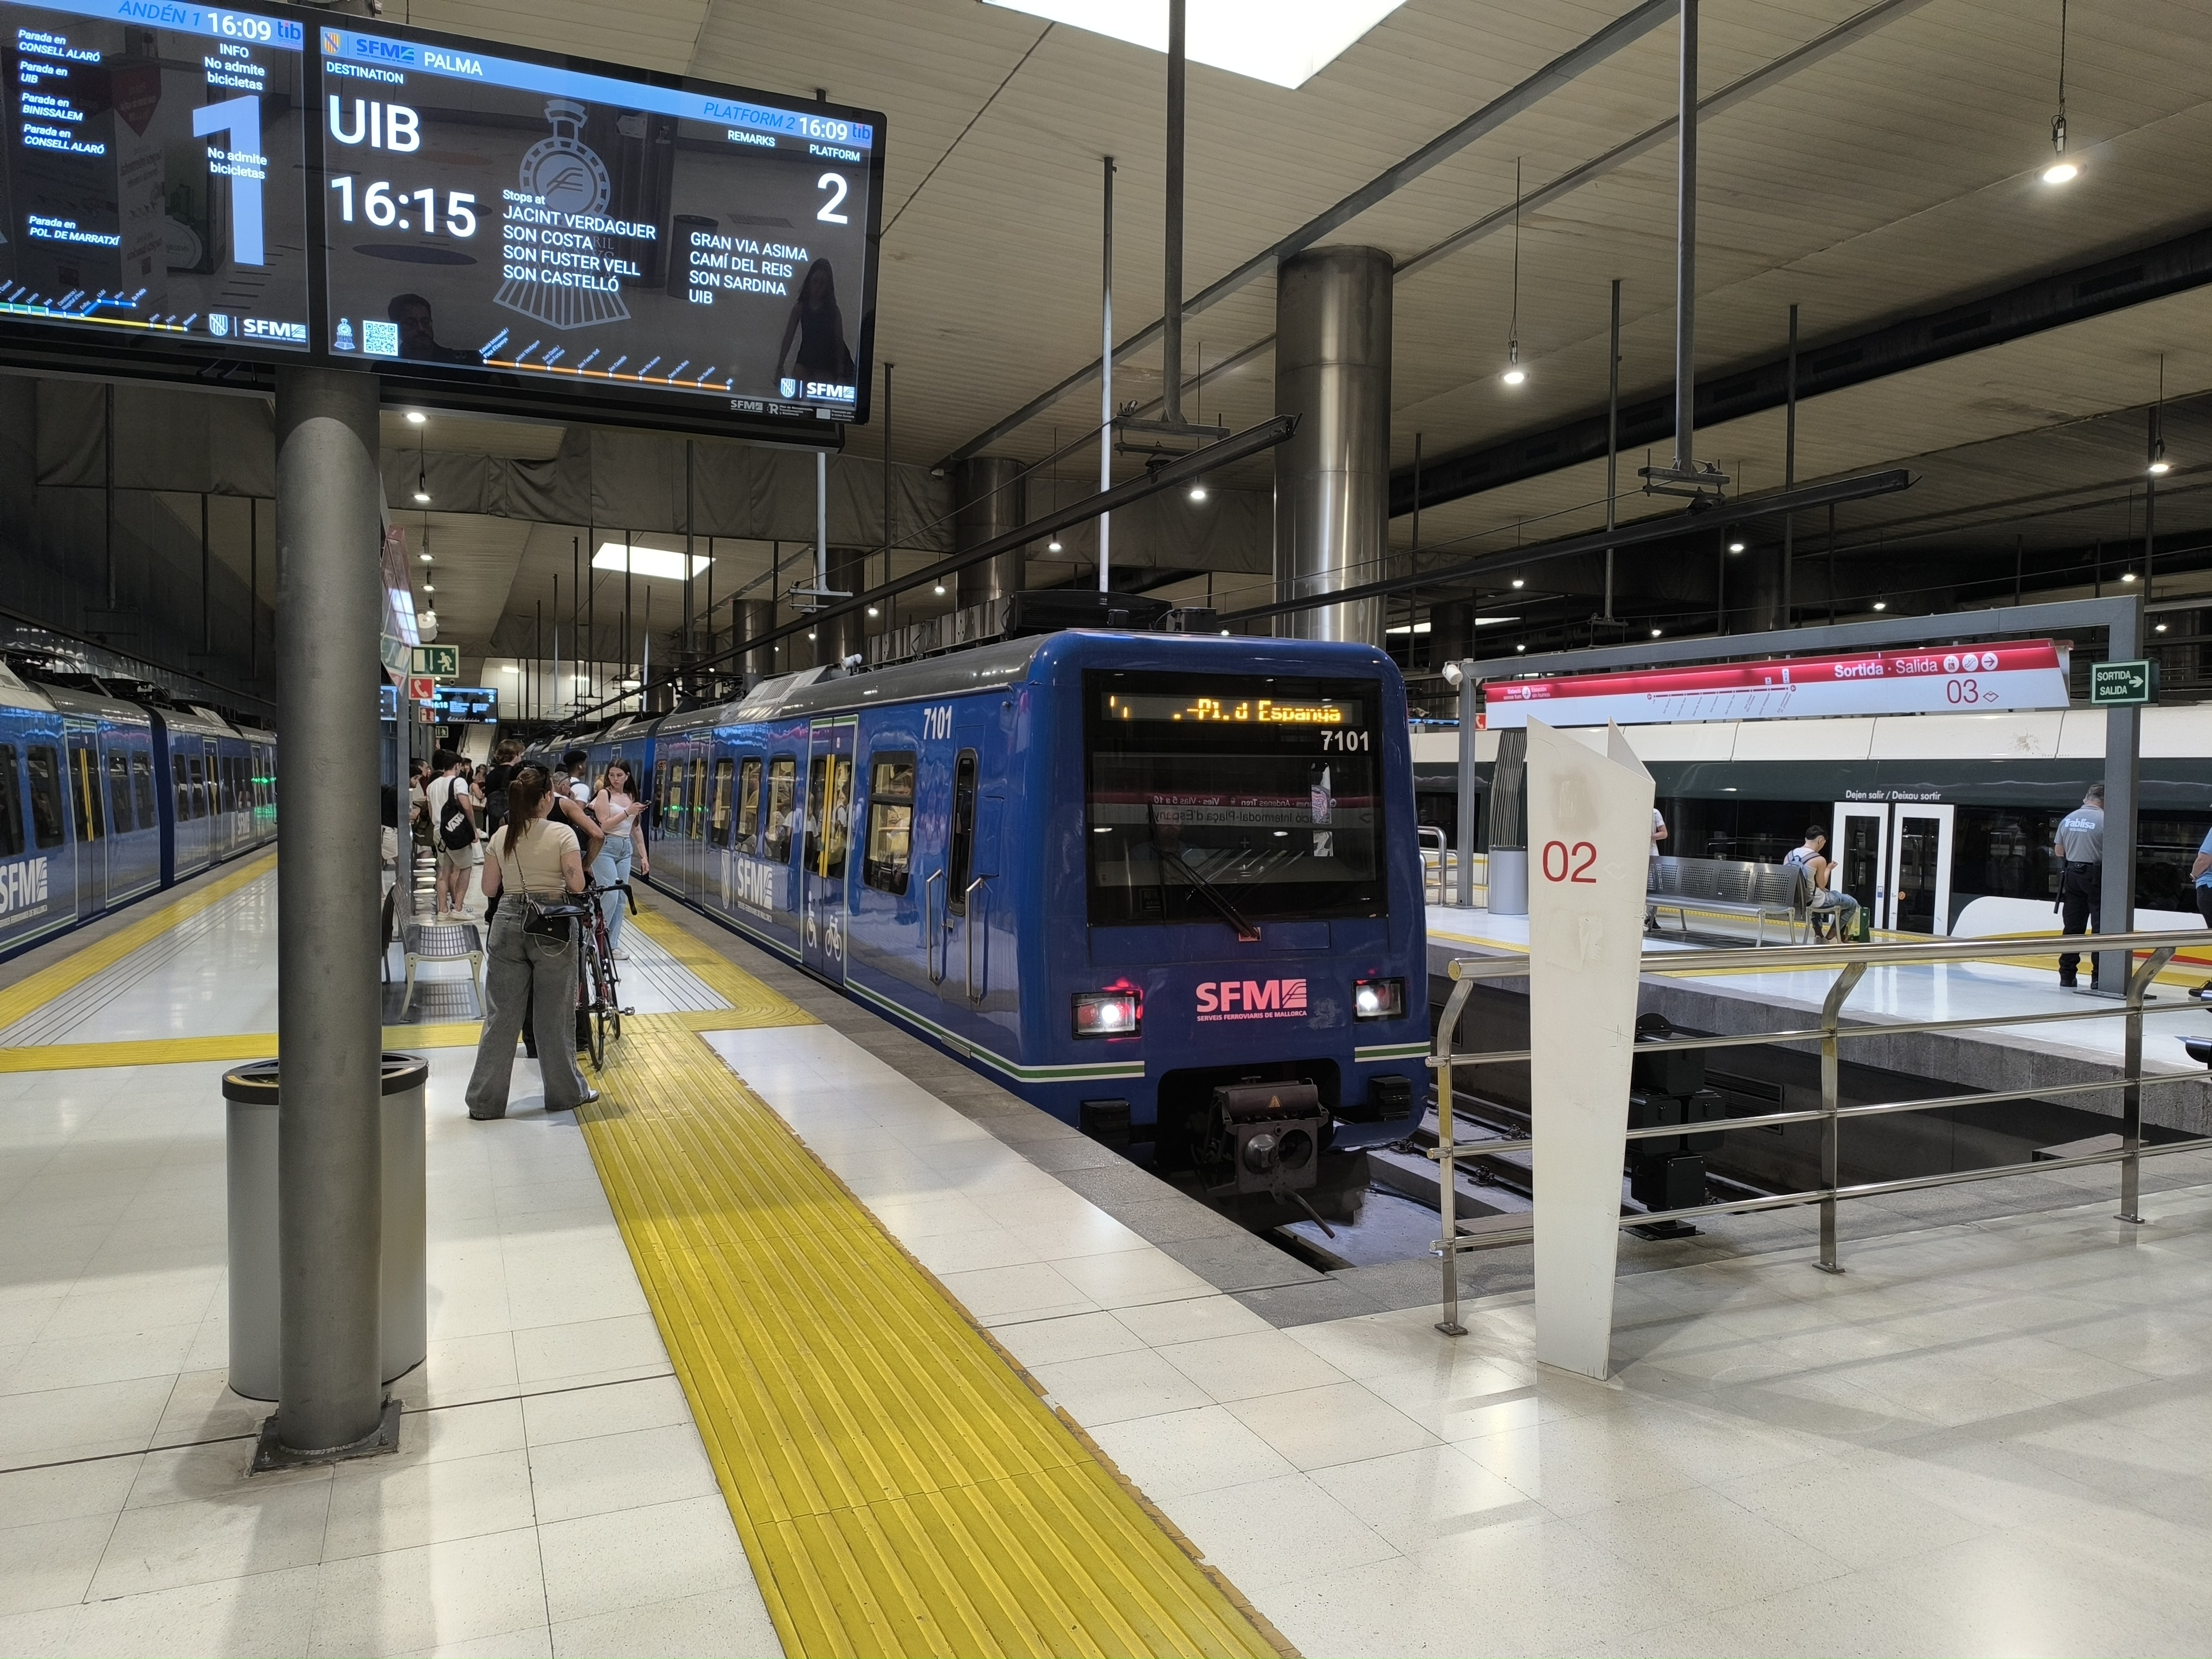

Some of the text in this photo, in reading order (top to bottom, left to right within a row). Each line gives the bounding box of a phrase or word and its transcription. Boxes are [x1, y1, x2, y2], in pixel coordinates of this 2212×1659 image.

[118, 0, 201, 26] ANDÉN 1
[208, 12, 271, 41] 16:09
[278, 22, 301, 40] tib
[18, 29, 66, 45] Parada en
[20, 42, 100, 62] CONSELL ALARÓ
[220, 44, 249, 58] INFO
[357, 39, 400, 58] SFM
[425, 52, 483, 76] PALMA
[20, 61, 68, 76] Parada en
[204, 57, 265, 76] No admite
[327, 61, 403, 84] DESTINATION
[21, 73, 38, 83] UIB
[208, 71, 263, 91] bicicletas
[22, 93, 69, 107] Parada en
[22, 105, 83, 121] BINISSALEM
[704, 102, 796, 130] PLATFORM 2
[24, 124, 71, 139] Parada en
[330, 95, 420, 152] UIB
[799, 117, 848, 141] 16:09
[853, 124, 870, 139] tib
[24, 136, 105, 155] CONSELL ALARÓ
[728, 130, 775, 147] REMARKS
[208, 147, 267, 165] No admite
[809, 144, 860, 162] PLATFORM
[210, 162, 266, 179] bicicletas
[192, 95, 264, 266] 1
[331, 176, 477, 237] 16:15
[503, 189, 545, 205] Stops at
[817, 172, 848, 224] 2
[29, 216, 76, 229] Parada en
[503, 205, 655, 240] JACINT VERDAGUER
[30, 227, 120, 246] POL. DE MARRATXÍ
[503, 225, 537, 242] SON
[541, 230, 594, 250] COSTA
[691, 232, 808, 261] GRAN VIA ASIMA
[503, 245, 537, 262] SON
[542, 250, 601, 270] FUSTER
[603, 258, 640, 276] VELL
[690, 250, 793, 278] CAMÍ DEL REIS
[503, 265, 619, 293] SON CASTELLÓ
[690, 270, 787, 295] SON SARDINA
[689, 288, 713, 305] UIB
[244, 319, 291, 337] SFM
[807, 382, 843, 397] SFM
[731, 400, 755, 410] SFM
[1835, 658, 1938, 677] Sortida Salida
[2097, 670, 2131, 681] SORTIDA
[1947, 679, 1978, 704] 03
[2100, 685, 2127, 696] SALIDA
[923, 705, 953, 740] 7101
[1321, 730, 1369, 751] 7101
[1846, 790, 1867, 800] Dejen
[1868, 790, 1885, 799] salir
[1892, 790, 1918, 800] Deixau
[1920, 792, 1941, 800] sortir
[446, 811, 465, 832] VANS
[2065, 818, 2095, 829] Trablisa
[1542, 840, 1597, 884] 02
[0, 860, 36, 914] SFM
[738, 858, 763, 906] SFM
[1196, 980, 1280, 1012] SFM
